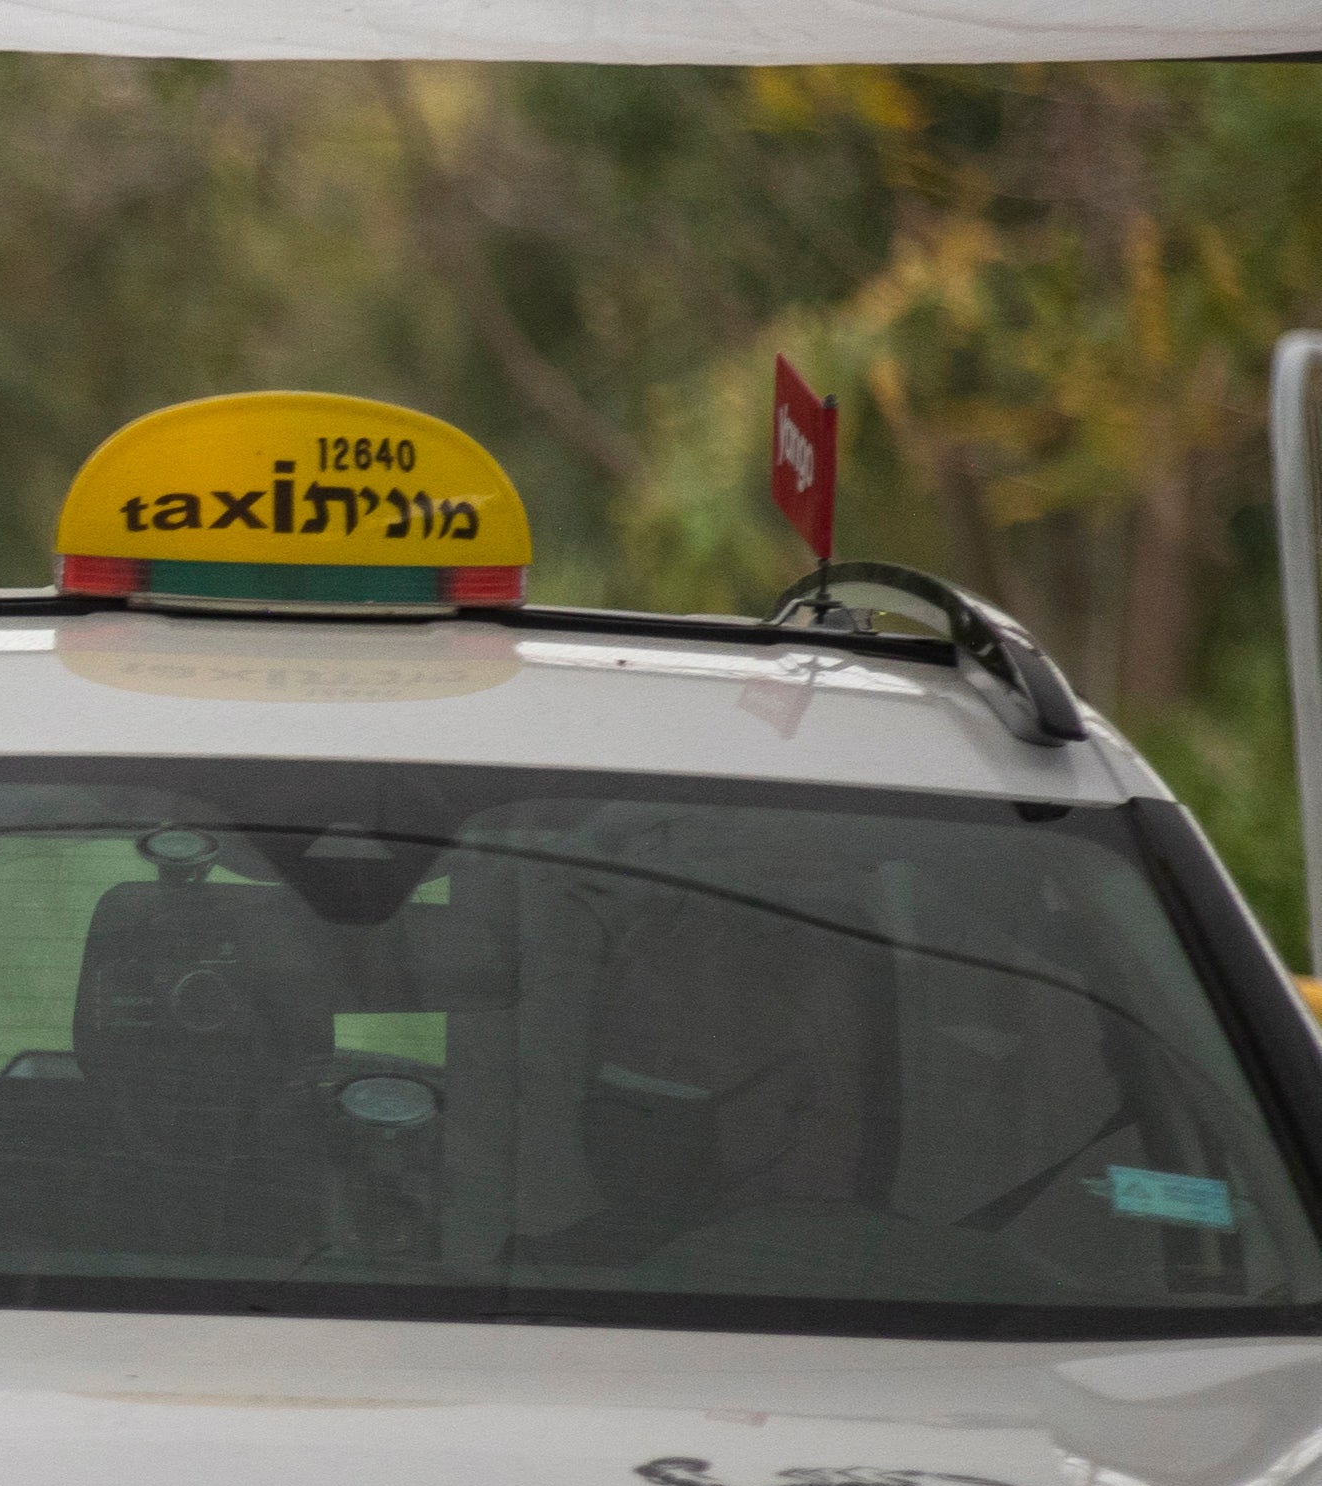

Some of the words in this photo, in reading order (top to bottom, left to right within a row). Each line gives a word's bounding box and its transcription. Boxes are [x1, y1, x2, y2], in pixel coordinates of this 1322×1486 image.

[318, 437, 417, 473] 12640
[120, 461, 297, 534] taxi
[300, 481, 482, 541] מונית
